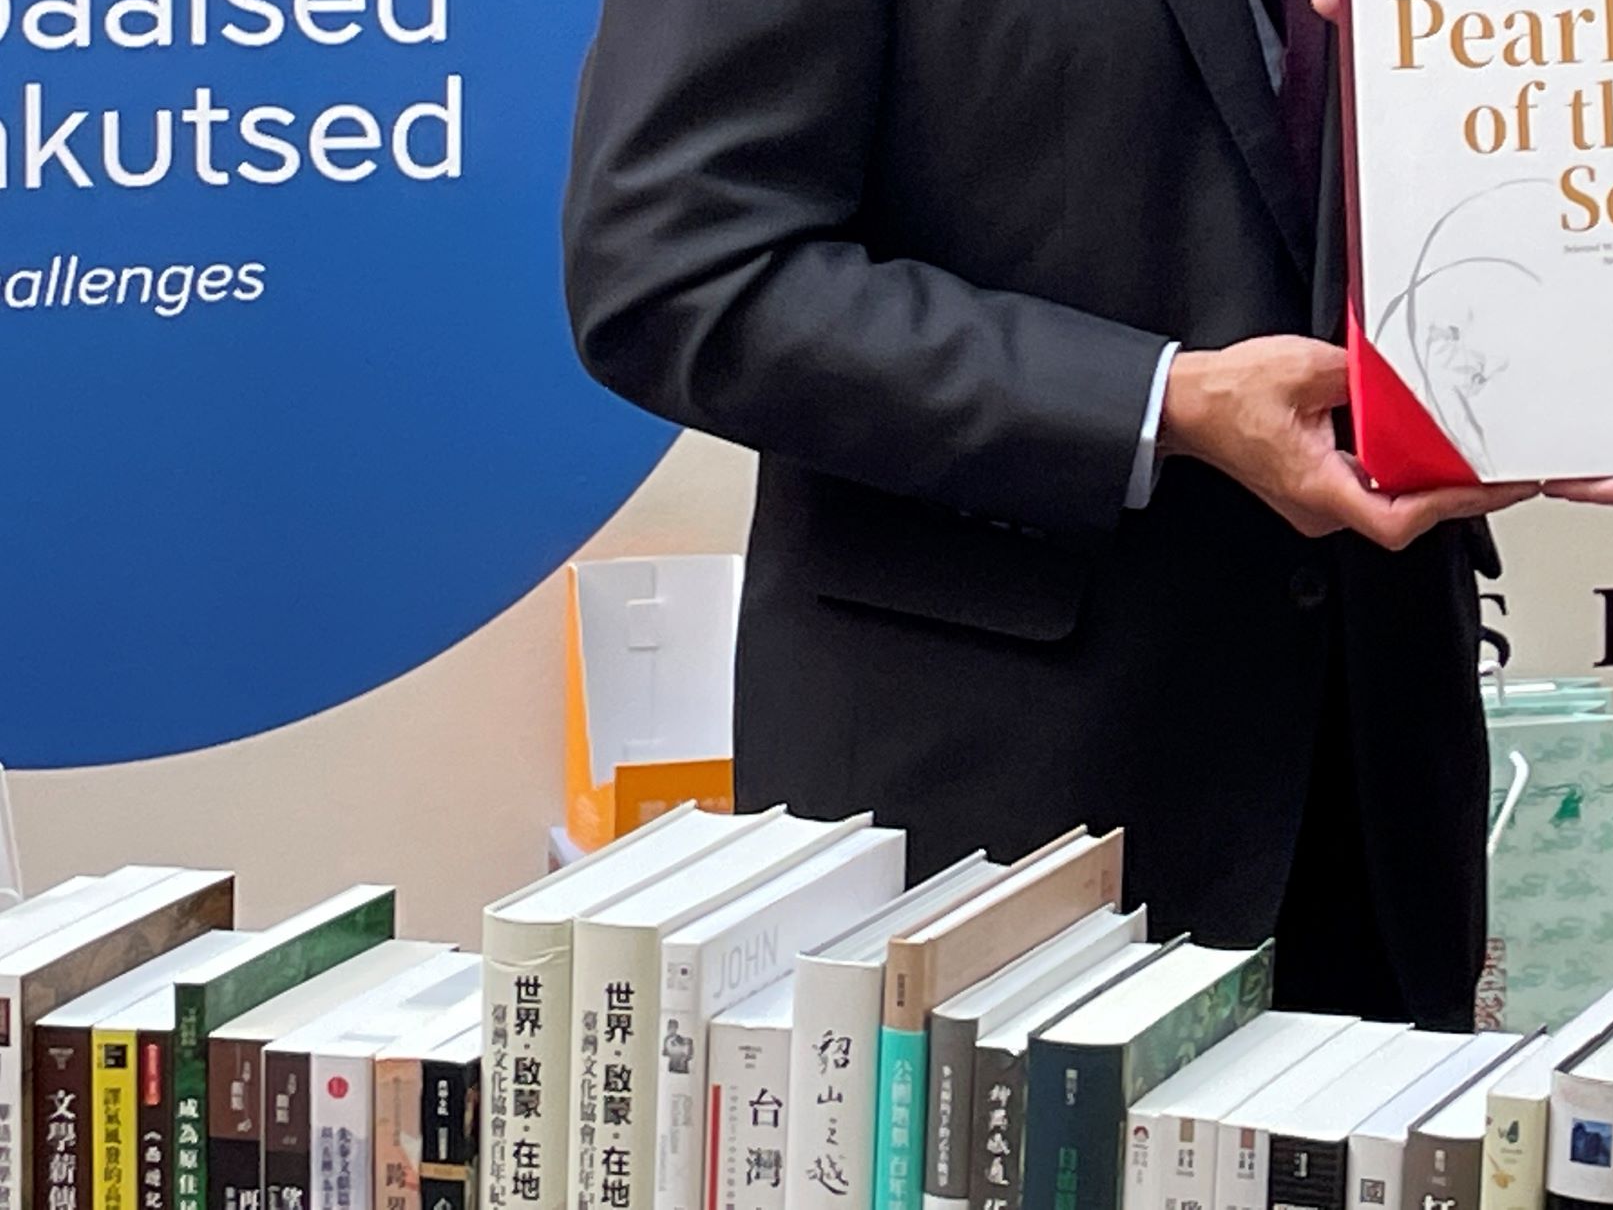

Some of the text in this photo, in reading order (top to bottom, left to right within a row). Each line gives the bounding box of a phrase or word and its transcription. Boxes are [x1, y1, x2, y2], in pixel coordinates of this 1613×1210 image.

[0, 74, 463, 189] kutsed
[1463, 80, 1546, 154] of
[712, 925, 779, 1000] JOHN
